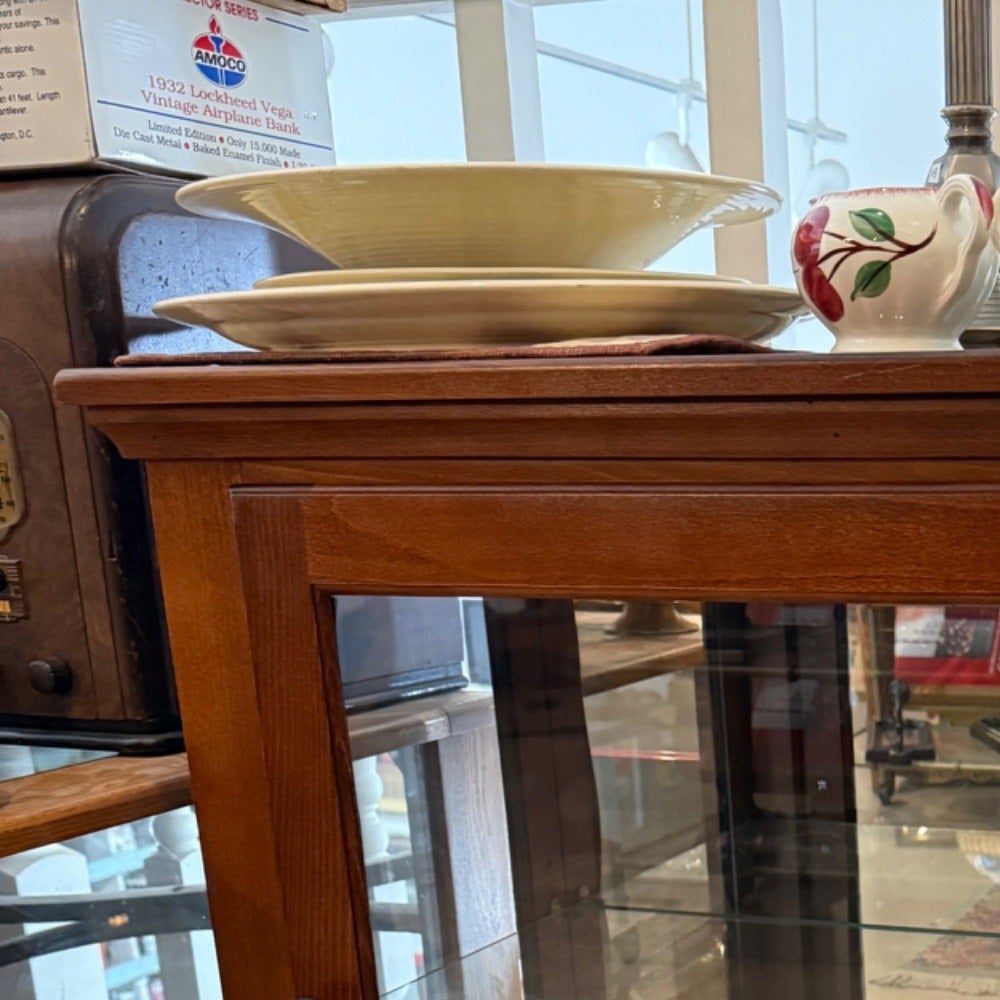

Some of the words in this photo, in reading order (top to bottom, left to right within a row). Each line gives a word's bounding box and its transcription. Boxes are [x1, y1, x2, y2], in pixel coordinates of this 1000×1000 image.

[44, 16, 60, 26] This
[224, 1, 259, 21] SERIES
[31, 66, 47, 76] This
[194, 50, 246, 73] AMOCO
[36, 91, 61, 101] Length
[148, 75, 186, 95] 1932
[190, 84, 257, 111] Lockheed
[261, 100, 293, 120] Vega
[141, 89, 199, 115] Vintage
[203, 104, 262, 127] Airplane
[266, 116, 301, 136] Bank
[113, 126, 130, 140] Die
[132, 130, 154, 145] Cast
[156, 135, 182, 150] Metal
[192, 142, 220, 156] Baked
[222, 147, 254, 163] Enamel
[256, 154, 283, 168] Finish
[148, 119, 183, 137] Limited
[184, 127, 217, 143] Edition
[226, 135, 247, 151] Only
[280, 146, 301, 159] Made
